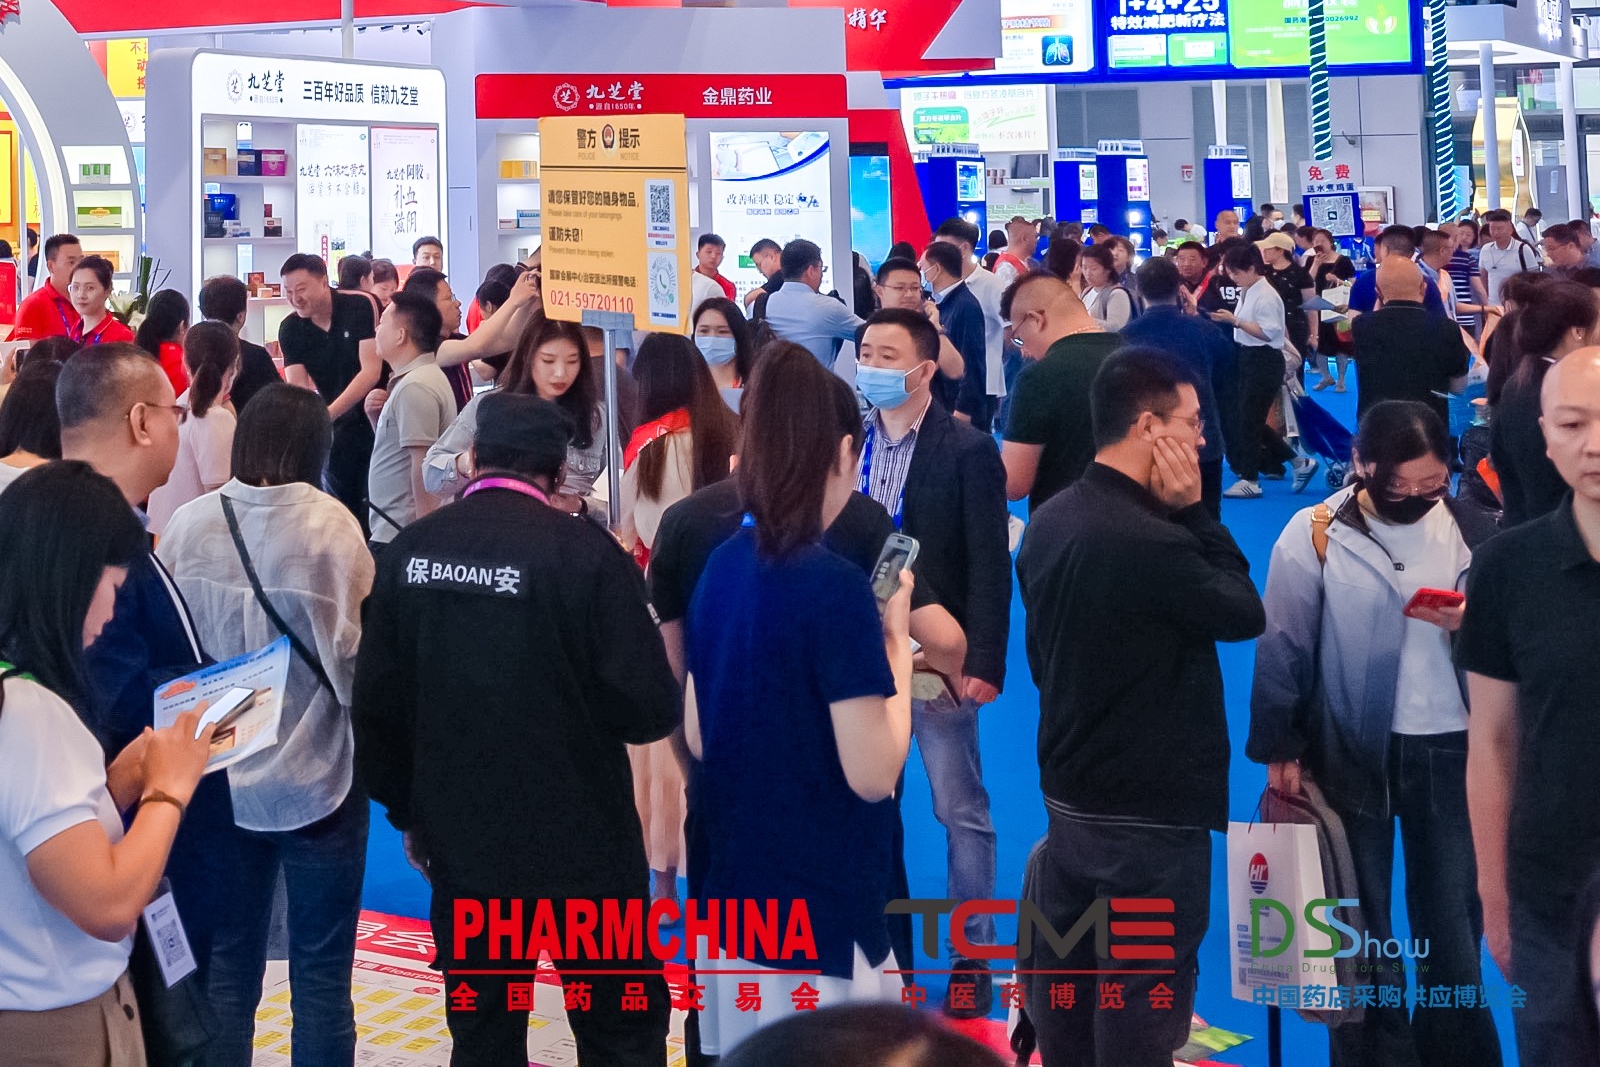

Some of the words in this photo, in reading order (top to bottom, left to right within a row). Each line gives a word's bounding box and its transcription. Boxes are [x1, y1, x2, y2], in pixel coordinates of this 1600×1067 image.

[1110, 12, 1226, 31] 特效减肥新疗法
[248, 69, 285, 93] 九芝堂
[586, 81, 645, 101] 九芝堂
[302, 80, 364, 103] 三百年好品质
[371, 84, 419, 106] 信赖九芝堂
[702, 86, 773, 106] 金鼎药业
[576, 128, 597, 149] 警方
[619, 128, 641, 149] 提示
[1308, 164, 1350, 181] 免费
[550, 289, 634, 313] 021-59720110
